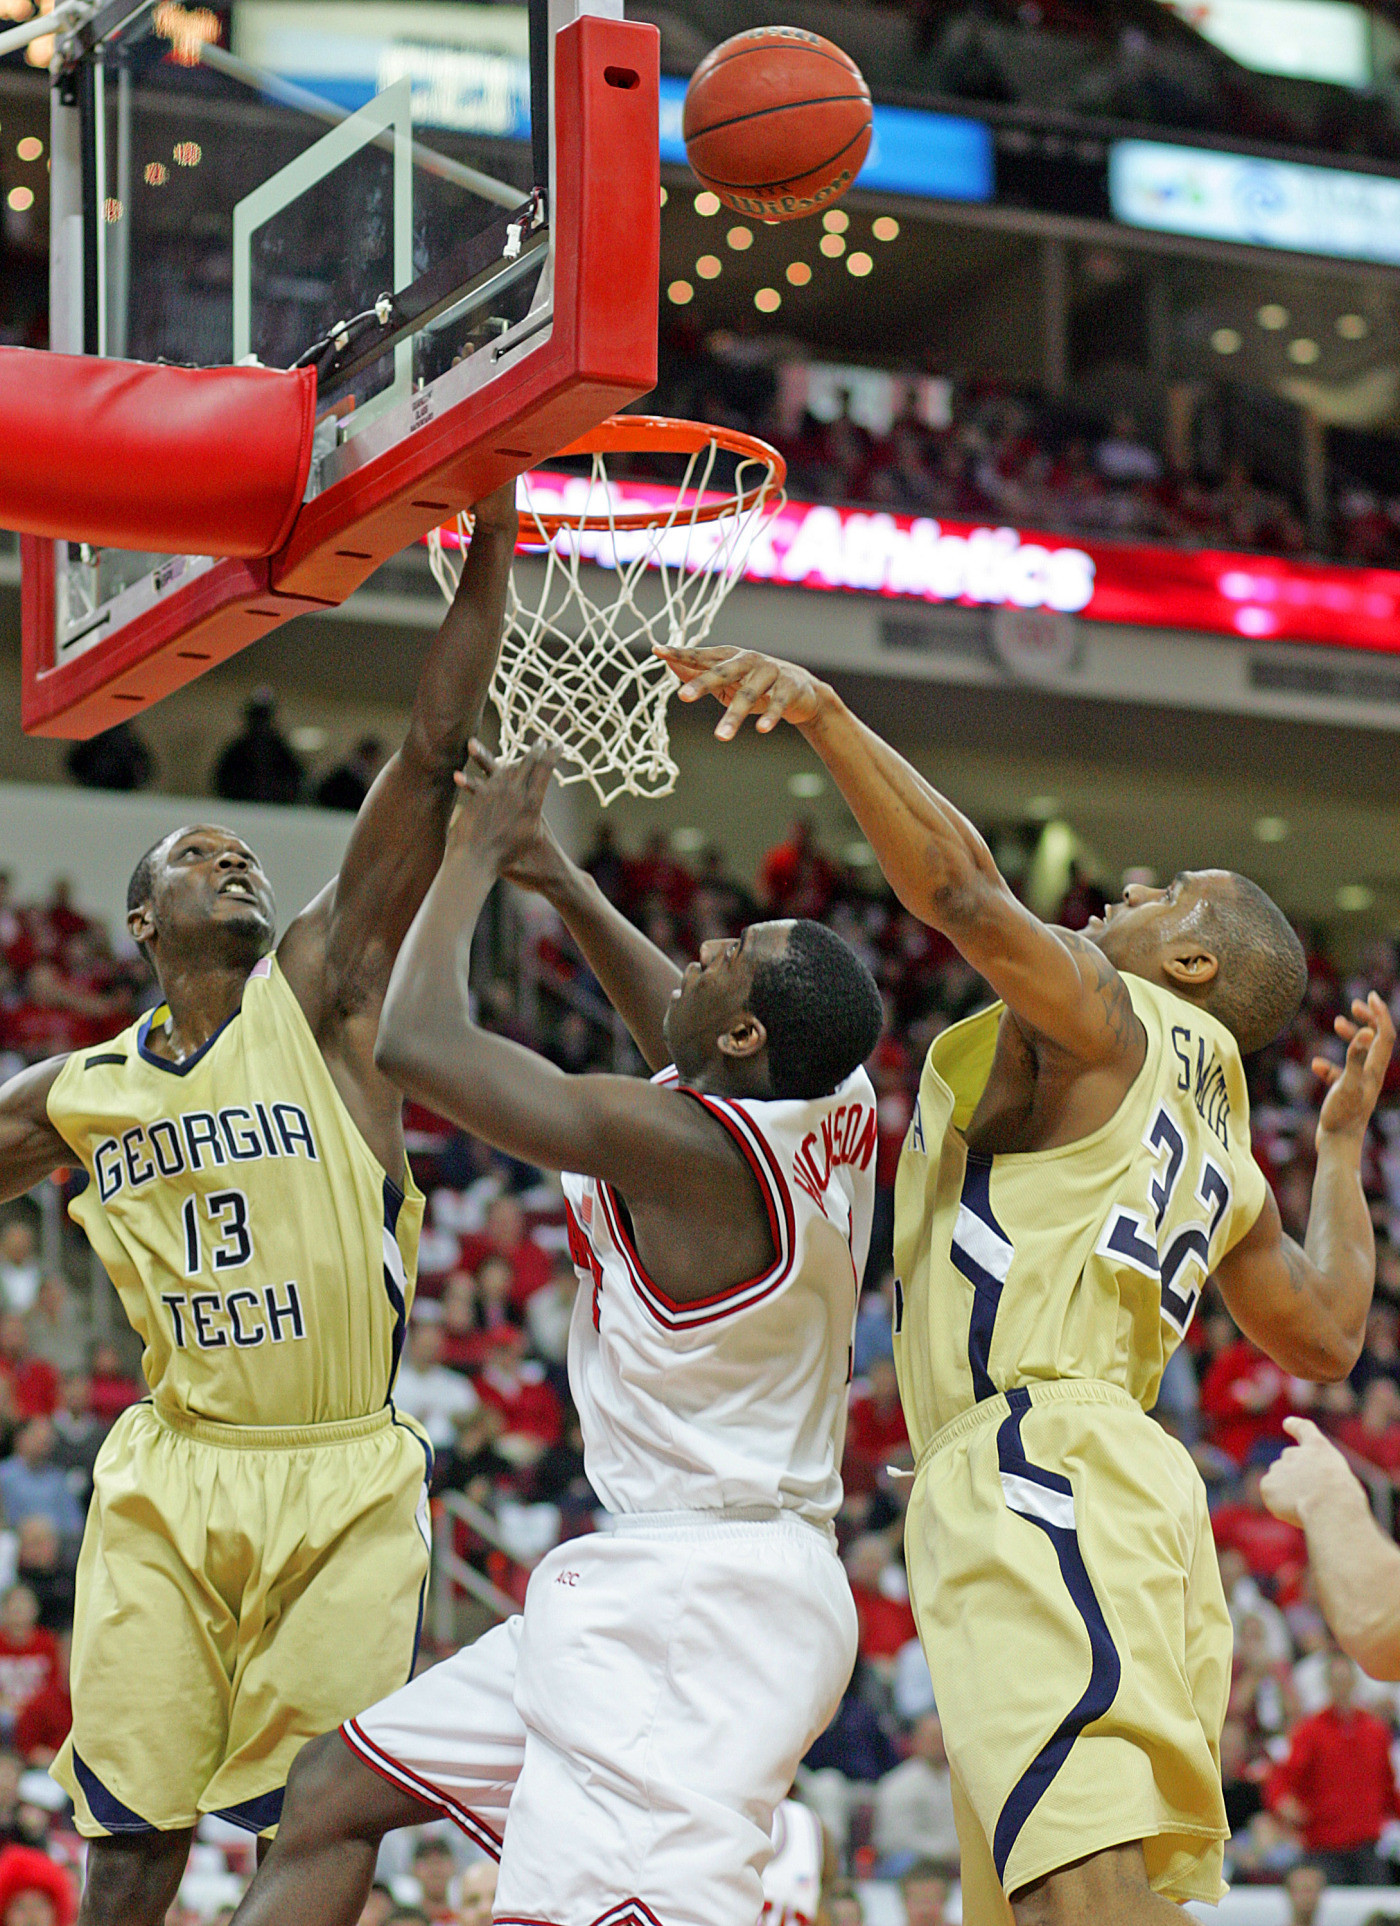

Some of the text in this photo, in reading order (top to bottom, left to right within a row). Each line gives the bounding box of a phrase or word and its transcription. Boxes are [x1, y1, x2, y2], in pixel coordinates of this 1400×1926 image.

[780, 505, 1096, 612] Athletics
[92, 1101, 320, 1206] GEORGIA
[181, 1187, 254, 1278] 13
[1095, 1097, 1233, 1341] 32
[159, 1280, 307, 1349] TECH
